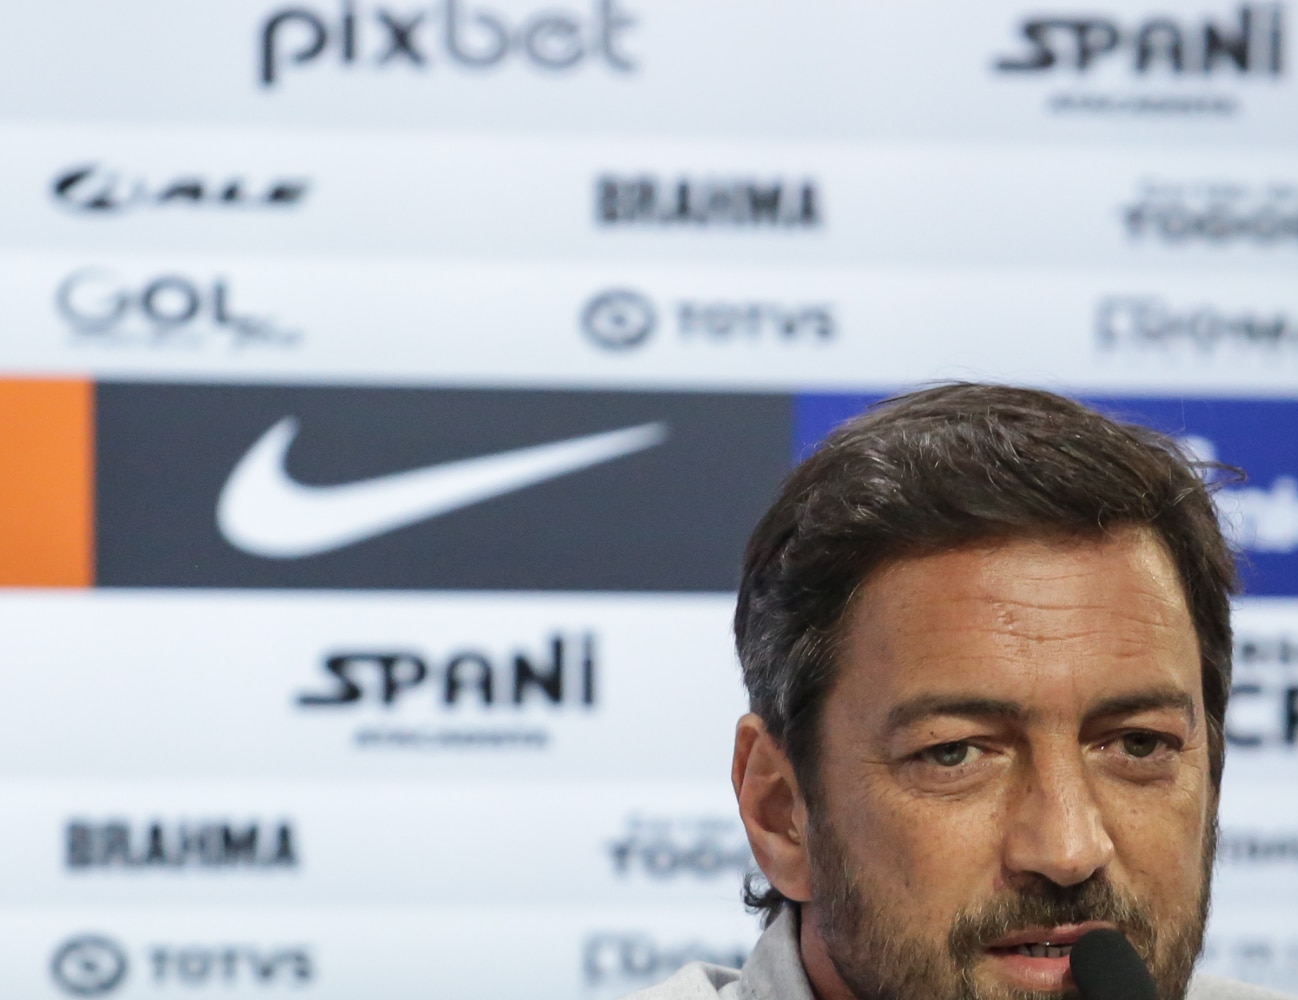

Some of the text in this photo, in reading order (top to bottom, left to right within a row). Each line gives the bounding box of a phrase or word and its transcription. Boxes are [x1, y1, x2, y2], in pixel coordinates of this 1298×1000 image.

[257, 0, 641, 88] pixbet
[993, 3, 1287, 80] SPANI
[592, 172, 826, 230] BRAHMA
[675, 300, 842, 343] TOTVS
[294, 632, 602, 712] SPANI
[63, 819, 300, 872] BRAHMA
[146, 944, 314, 988] TOTVS
